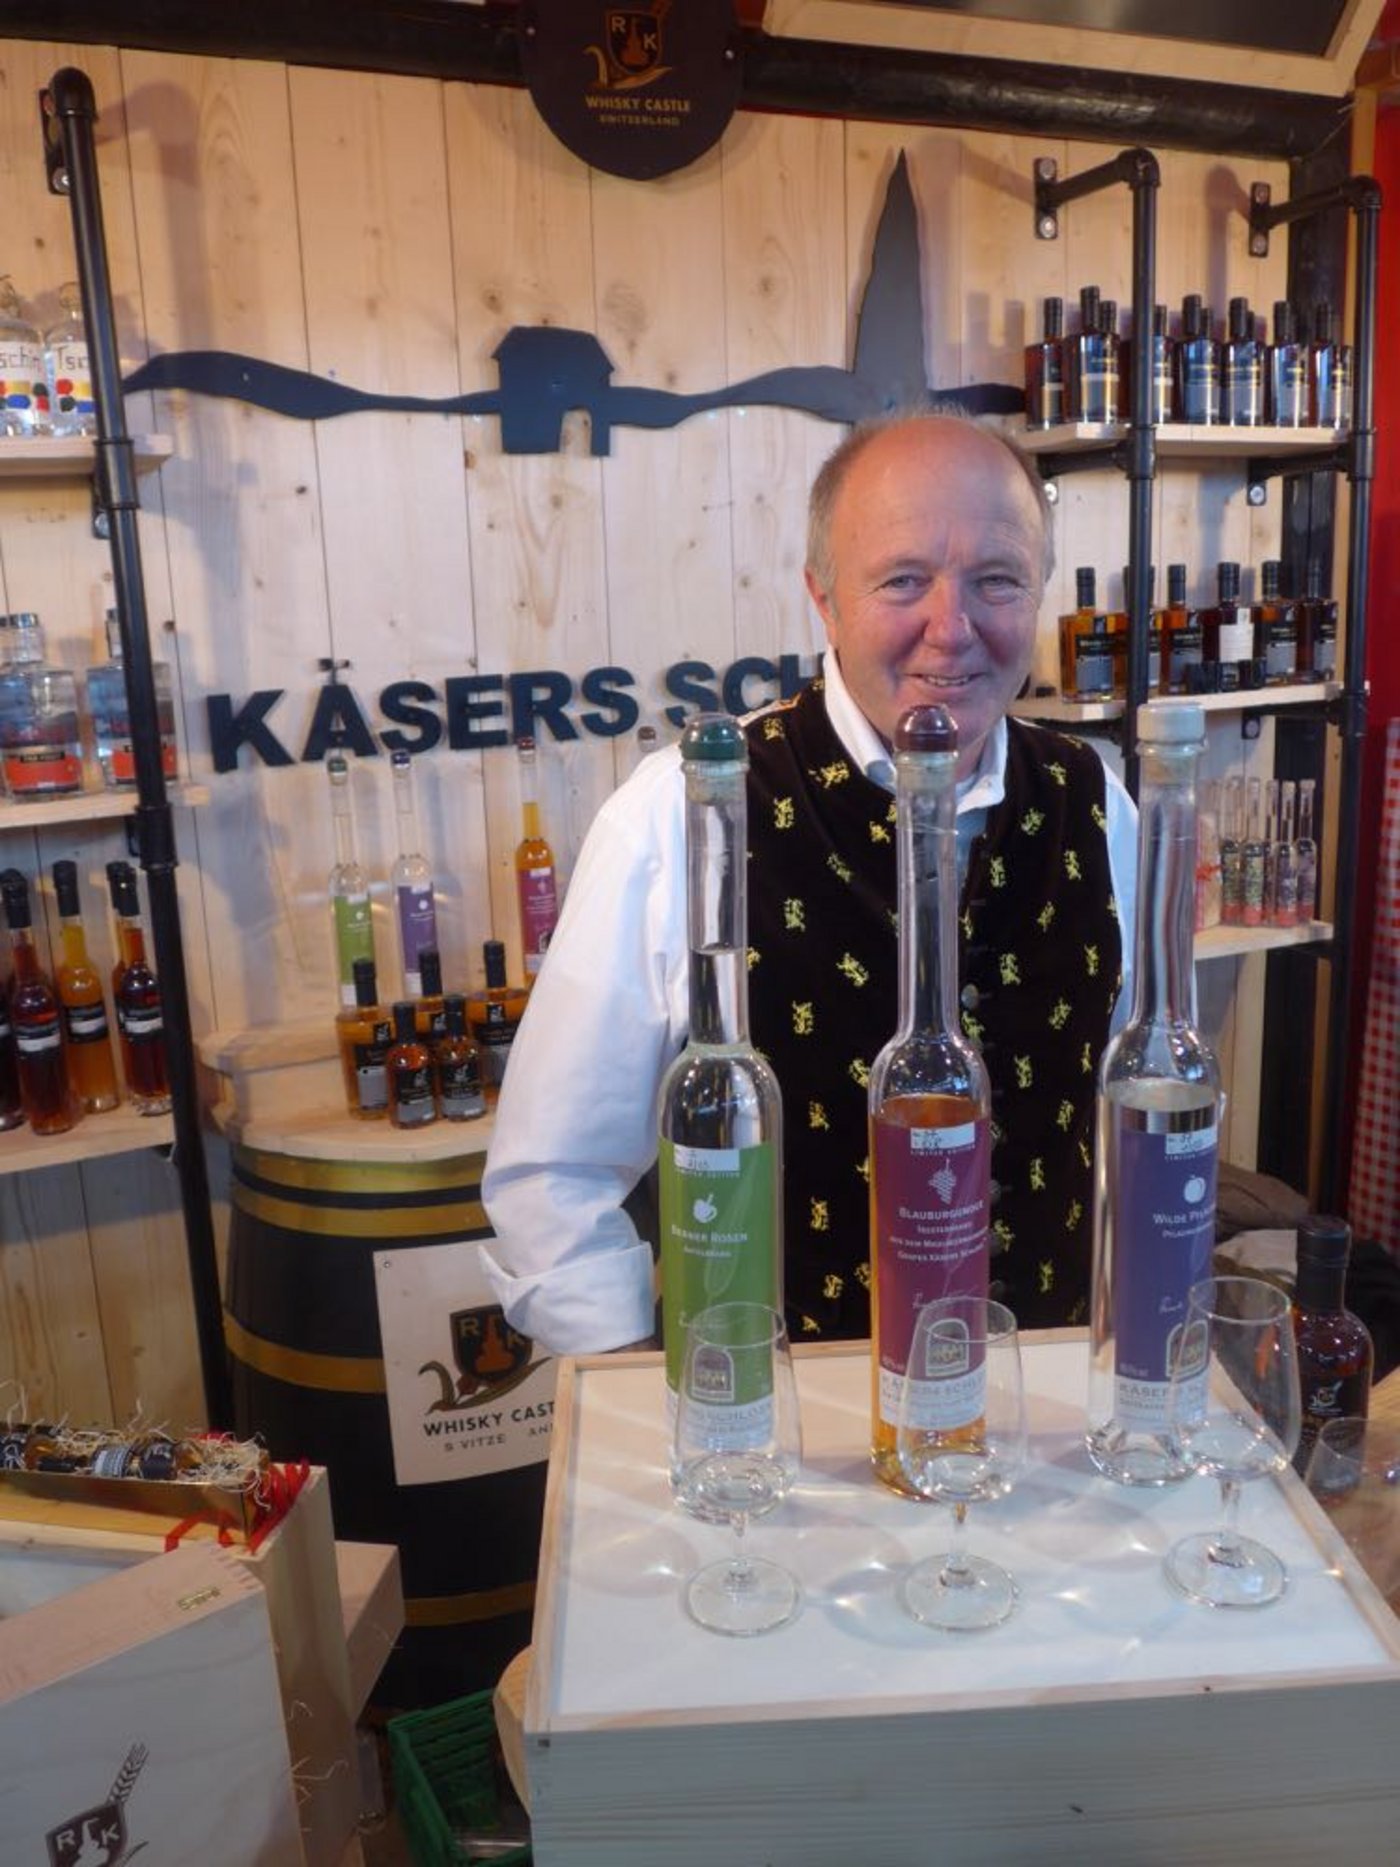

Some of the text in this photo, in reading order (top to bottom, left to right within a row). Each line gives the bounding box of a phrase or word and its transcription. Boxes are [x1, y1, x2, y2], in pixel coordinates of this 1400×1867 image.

[585, 95, 690, 113] WHISKY CASTLE
[206, 658, 640, 774] KÄSERS
[710, 1231, 748, 1244] ROSEN
[423, 1411, 504, 1437] WHISKY
[55, 1822, 120, 1851] R K
